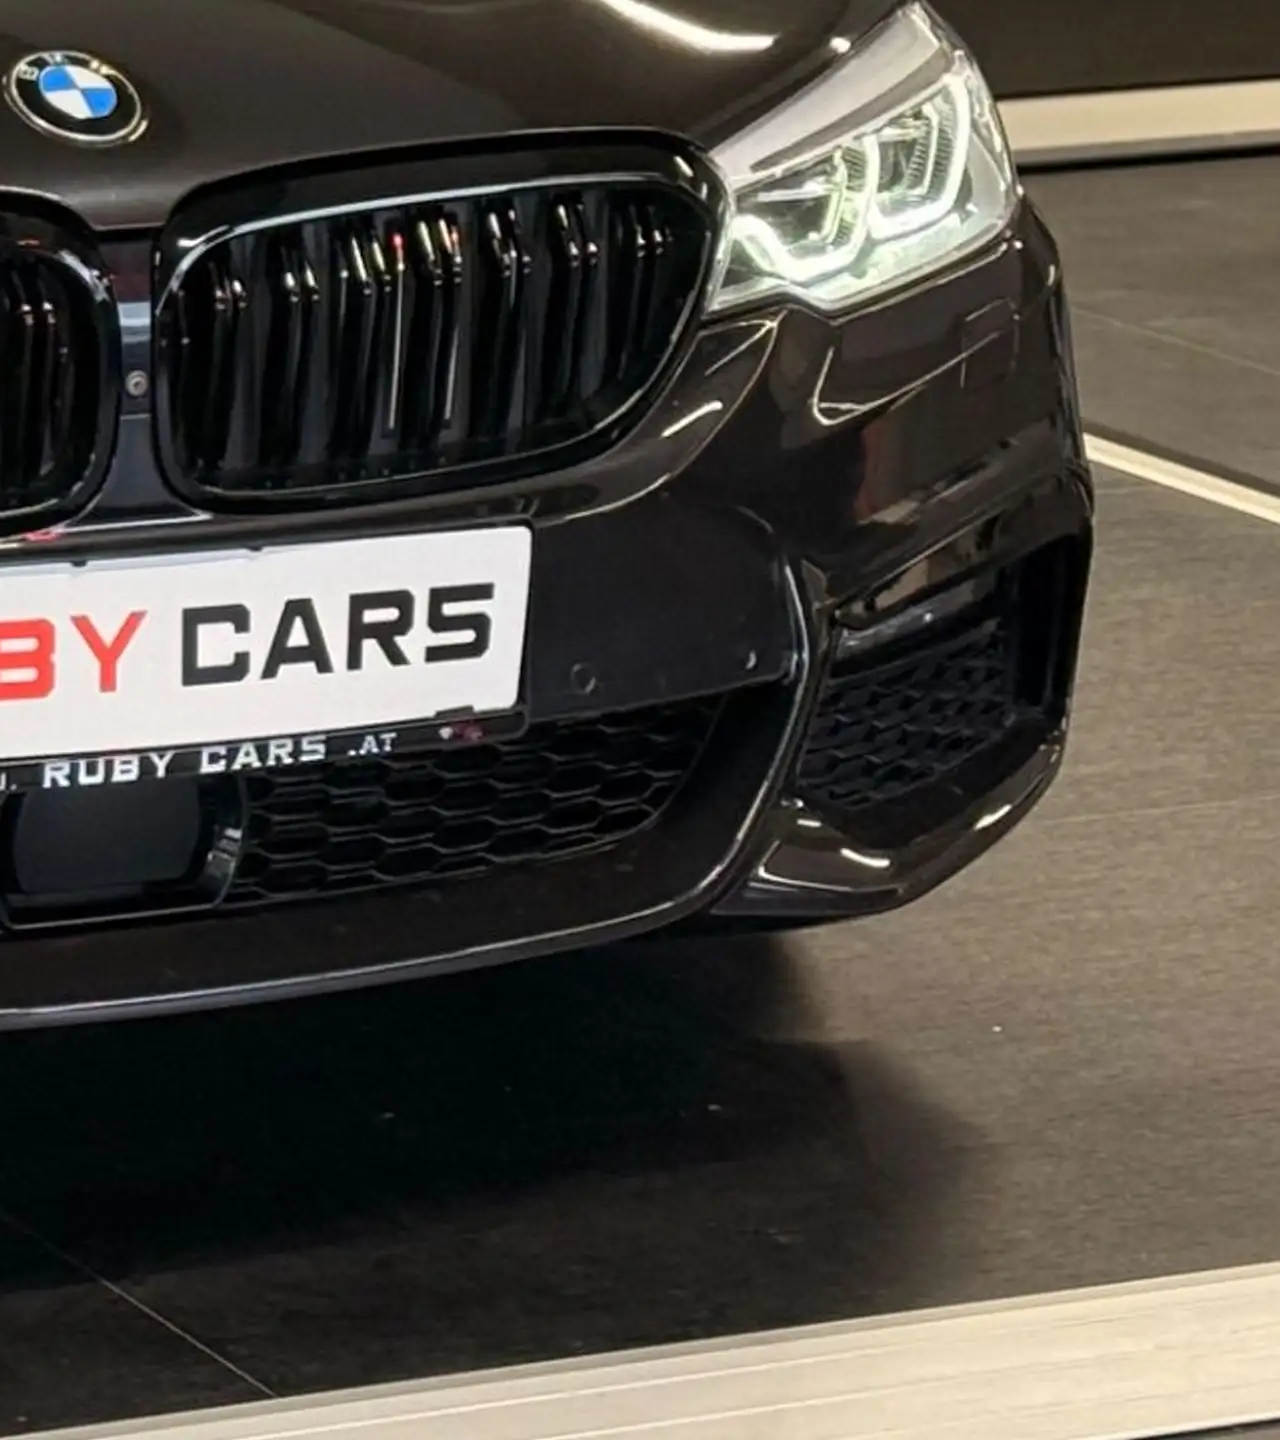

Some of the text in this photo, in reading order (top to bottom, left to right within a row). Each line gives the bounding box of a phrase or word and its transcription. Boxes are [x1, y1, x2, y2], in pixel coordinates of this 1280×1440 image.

[181, 582, 495, 686] CARS
[42, 752, 176, 788] RUBY
[199, 735, 328, 774] CARS
[347, 732, 397, 756] .AT
